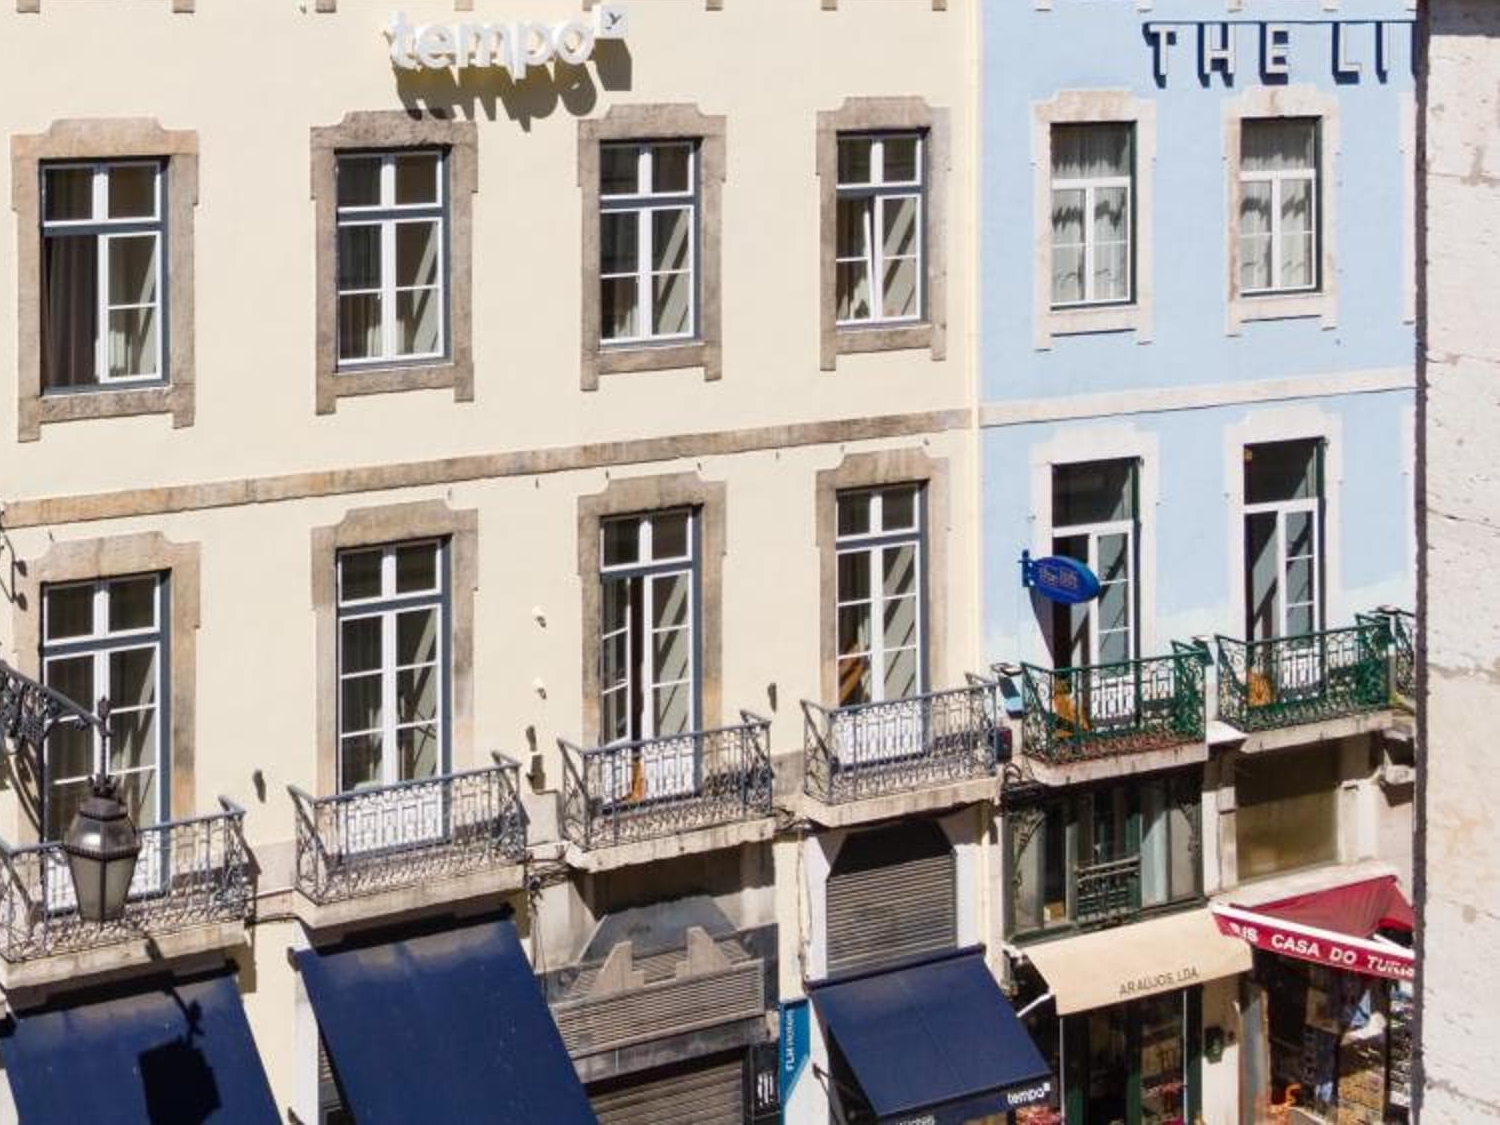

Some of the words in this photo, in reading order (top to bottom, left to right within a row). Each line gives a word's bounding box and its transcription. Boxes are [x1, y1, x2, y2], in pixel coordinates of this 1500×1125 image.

[387, 12, 596, 80] tempo
[1142, 22, 1289, 88] THE
[1332, 22, 1416, 85] LI
[1271, 934, 1320, 958] CASA
[1329, 947, 1358, 965] DO
[1007, 1087, 1045, 1105] tempo
